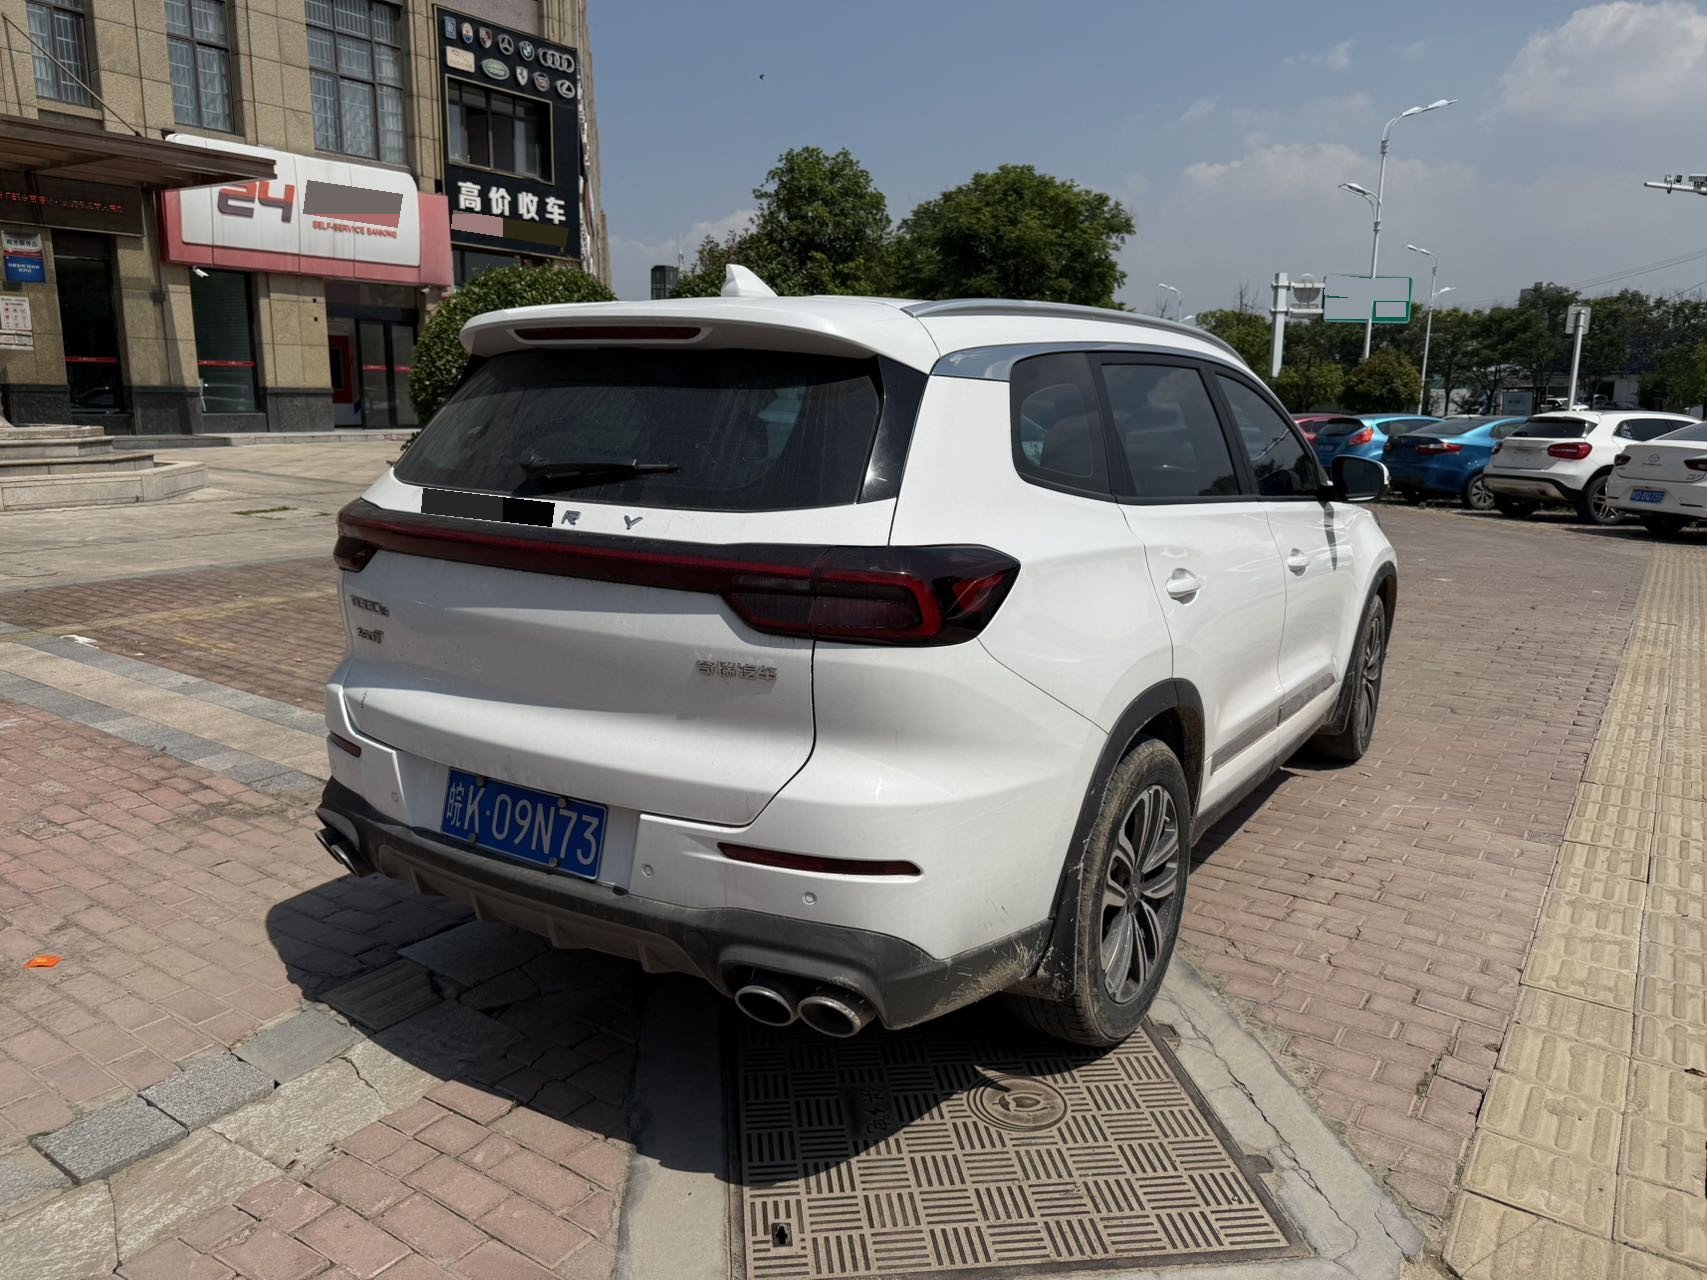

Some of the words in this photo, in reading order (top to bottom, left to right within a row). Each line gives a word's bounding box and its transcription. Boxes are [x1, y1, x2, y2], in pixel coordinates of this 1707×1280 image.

[218, 180, 295, 224] 24
[457, 181, 566, 225] 高价收车
[312, 220, 365, 235] SELF-SERVICE
[366, 227, 397, 239] BANKING
